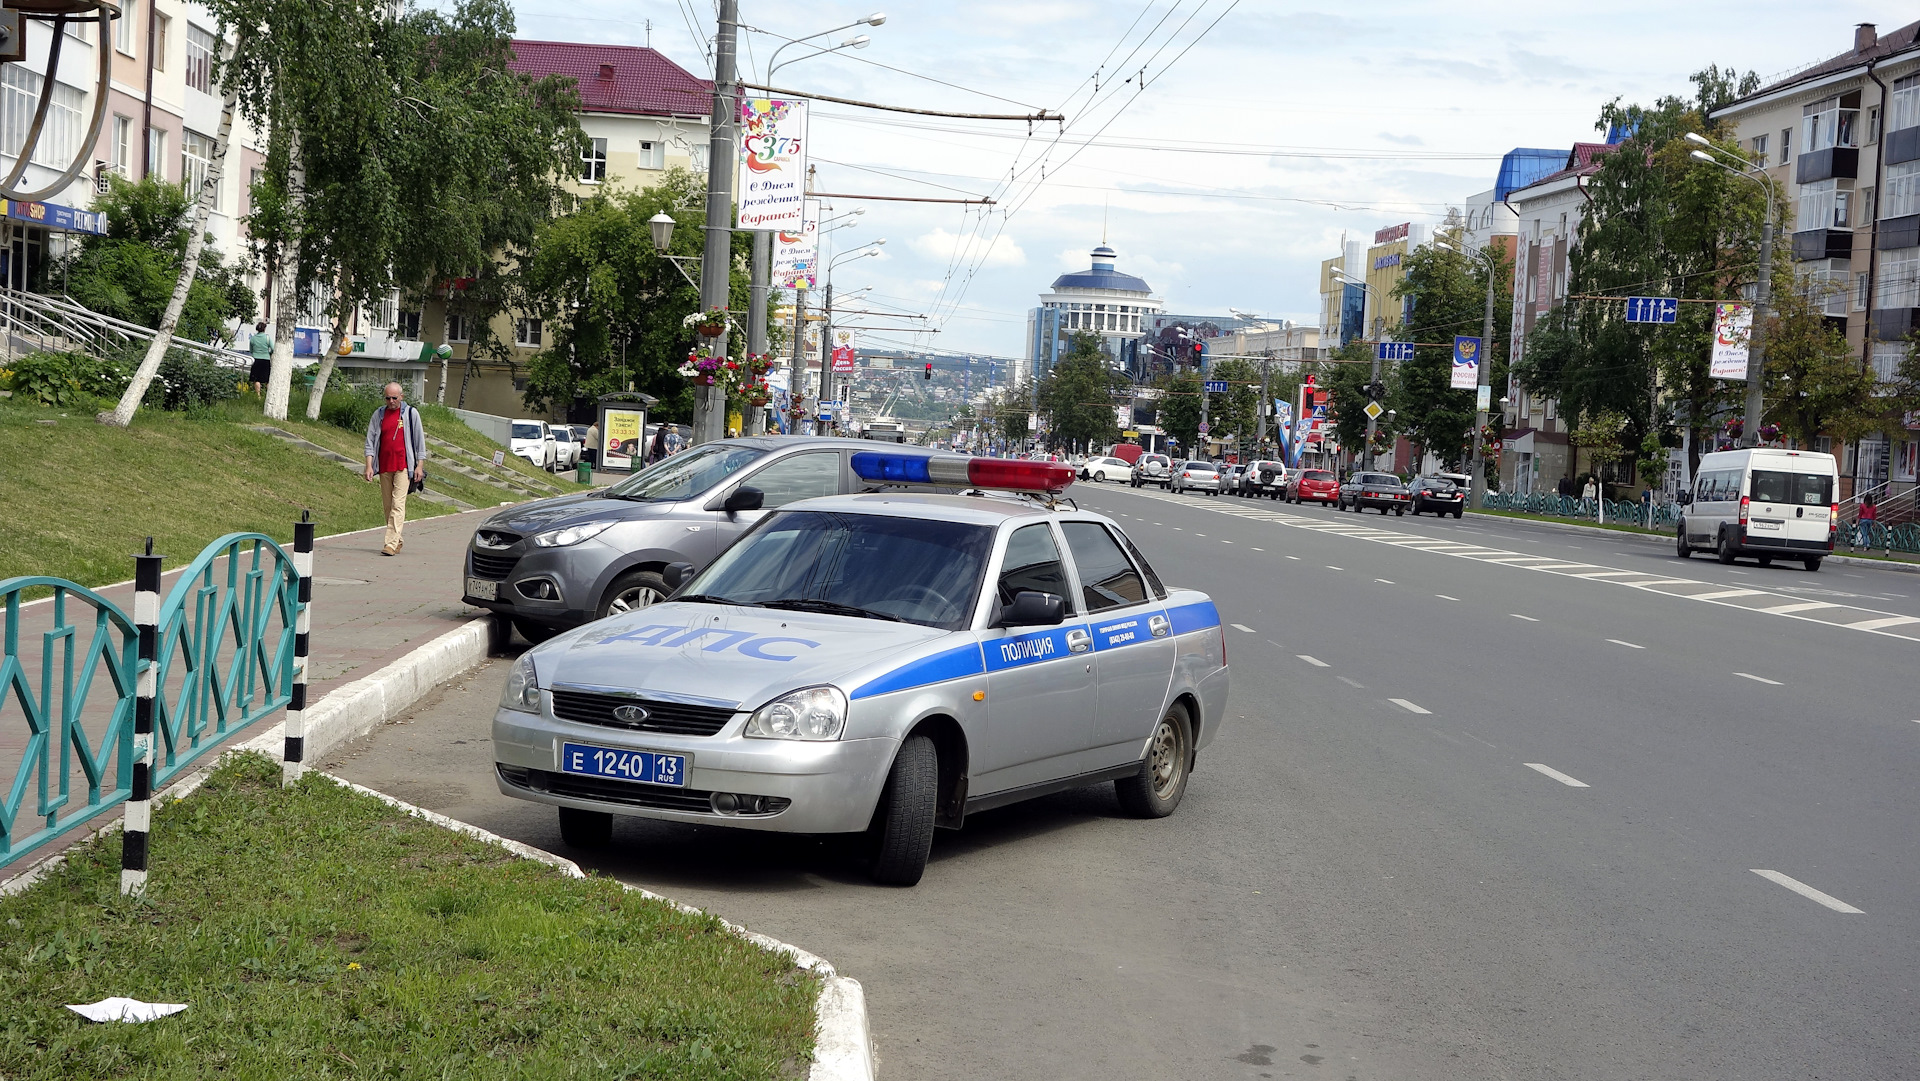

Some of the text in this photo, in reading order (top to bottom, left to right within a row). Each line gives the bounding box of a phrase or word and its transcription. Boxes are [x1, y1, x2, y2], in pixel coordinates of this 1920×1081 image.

[758, 136, 802, 160] 375
[750, 181, 794, 191] С Днем
[29, 203, 46, 219] SHOP
[741, 208, 801, 226] Саранск!
[1805, 493, 1813, 503] 32
[596, 624, 822, 662] ДПС
[1001, 637, 1054, 662] ПОЛИЦИЯ
[572, 750, 677, 777] E 1240 13
[658, 774, 674, 783] RUS
